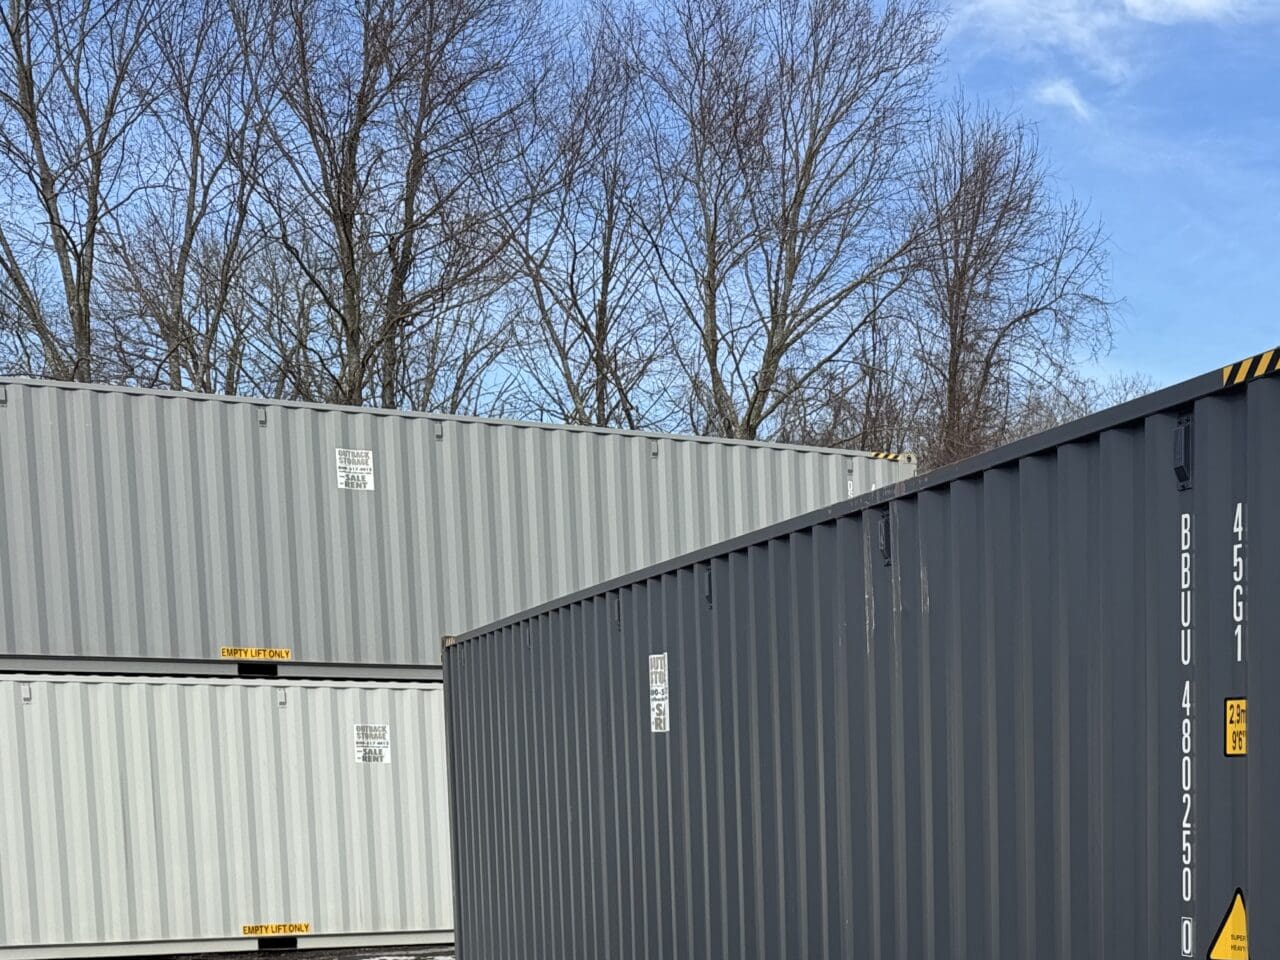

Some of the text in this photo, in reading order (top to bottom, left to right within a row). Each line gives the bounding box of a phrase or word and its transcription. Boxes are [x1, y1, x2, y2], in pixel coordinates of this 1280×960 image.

[1232, 502, 1244, 662] 45G1
[221, 647, 290, 659] EMPTY LIFT ONLY
[242, 923, 310, 935] EMPTY LIFT ONLY
